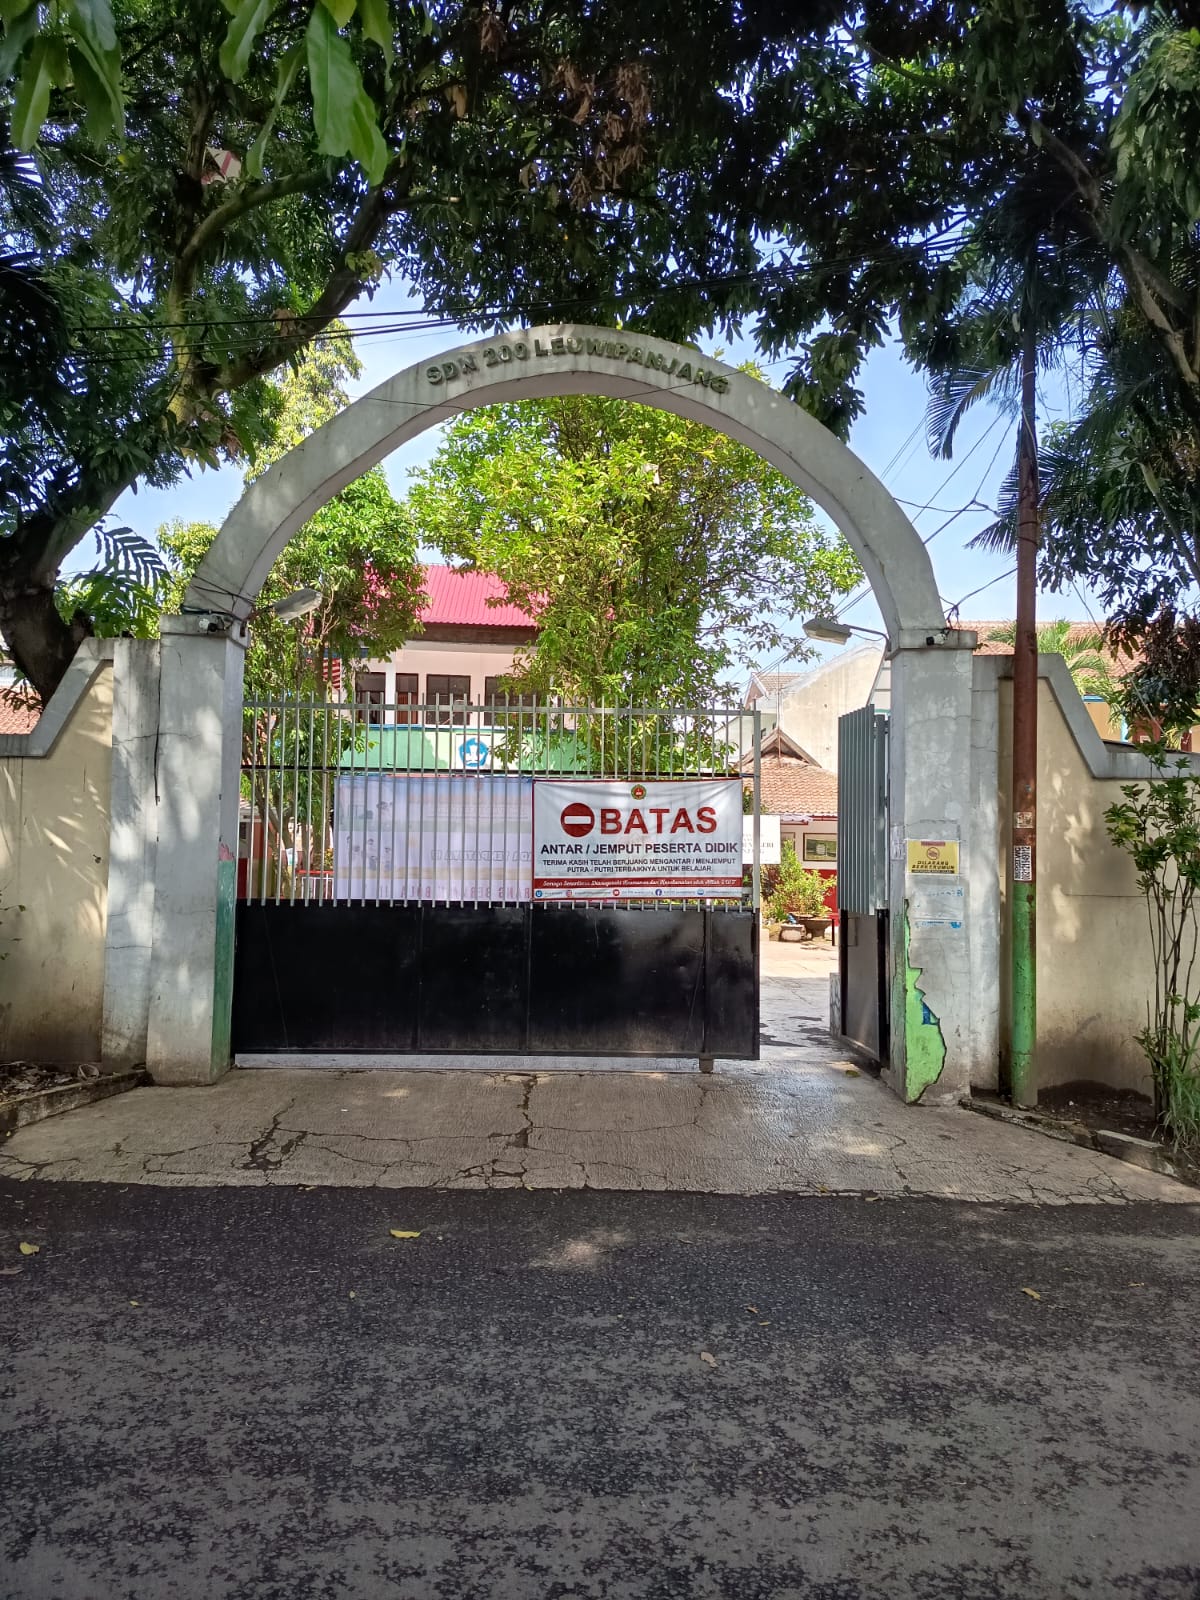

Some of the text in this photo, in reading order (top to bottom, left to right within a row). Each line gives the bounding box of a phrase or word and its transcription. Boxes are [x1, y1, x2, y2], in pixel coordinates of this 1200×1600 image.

[426, 355, 478, 385] SDN
[534, 337, 729, 394] LEUWIPANJANG
[600, 807, 717, 835] BATAS
[540, 844, 583, 854] ANTAR
[593, 843, 642, 854] JEMPUT
[645, 843, 701, 854] PESERTA
[705, 842, 738, 853] DIDIK
